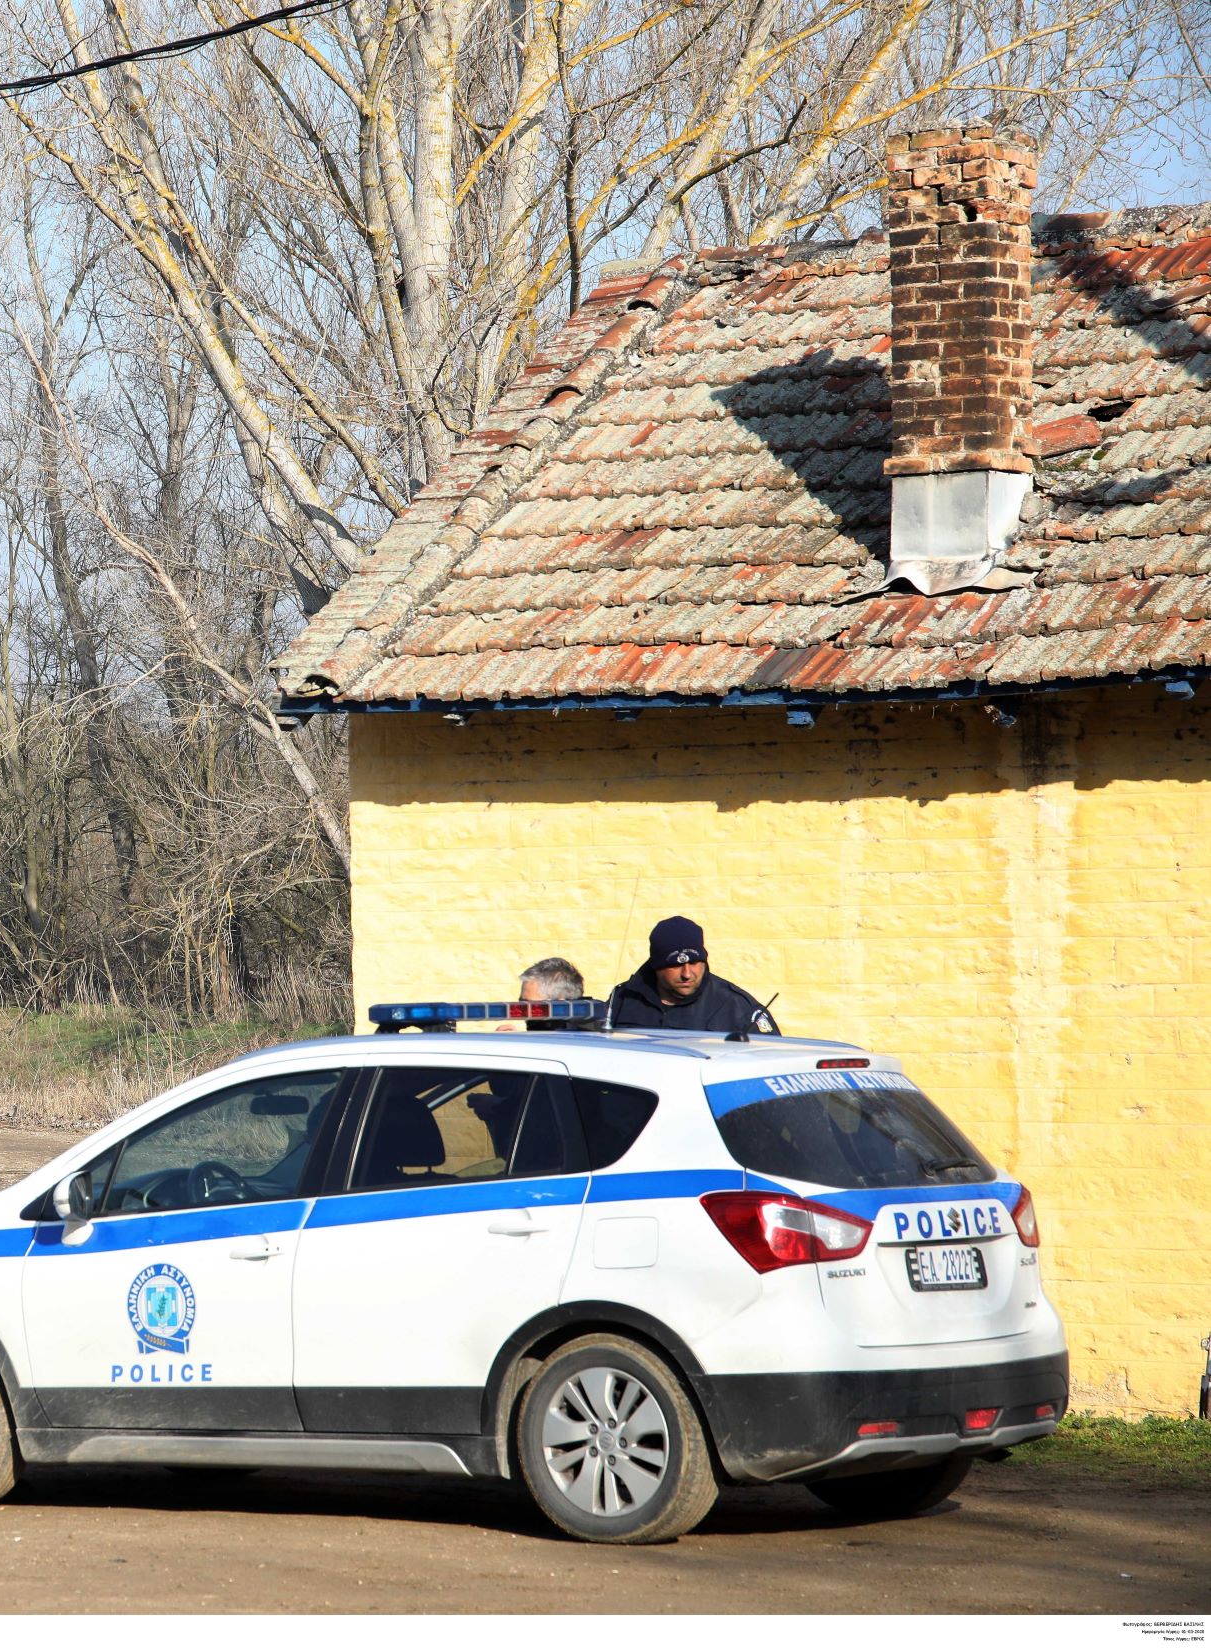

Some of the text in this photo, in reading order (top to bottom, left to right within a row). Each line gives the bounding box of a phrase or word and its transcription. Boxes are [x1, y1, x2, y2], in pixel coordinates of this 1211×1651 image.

[764, 1073, 852, 1096] ΕΛΛΗΝΙΚΗ
[893, 1206, 1001, 1240] POLICE
[827, 1268, 866, 1279] SUZUKI
[128, 1265, 195, 1332] ΕΛΛΗΝΙΚΗ ΑΣΤΥΝΟΜΙΑ
[111, 1364, 213, 1383] POLICE
